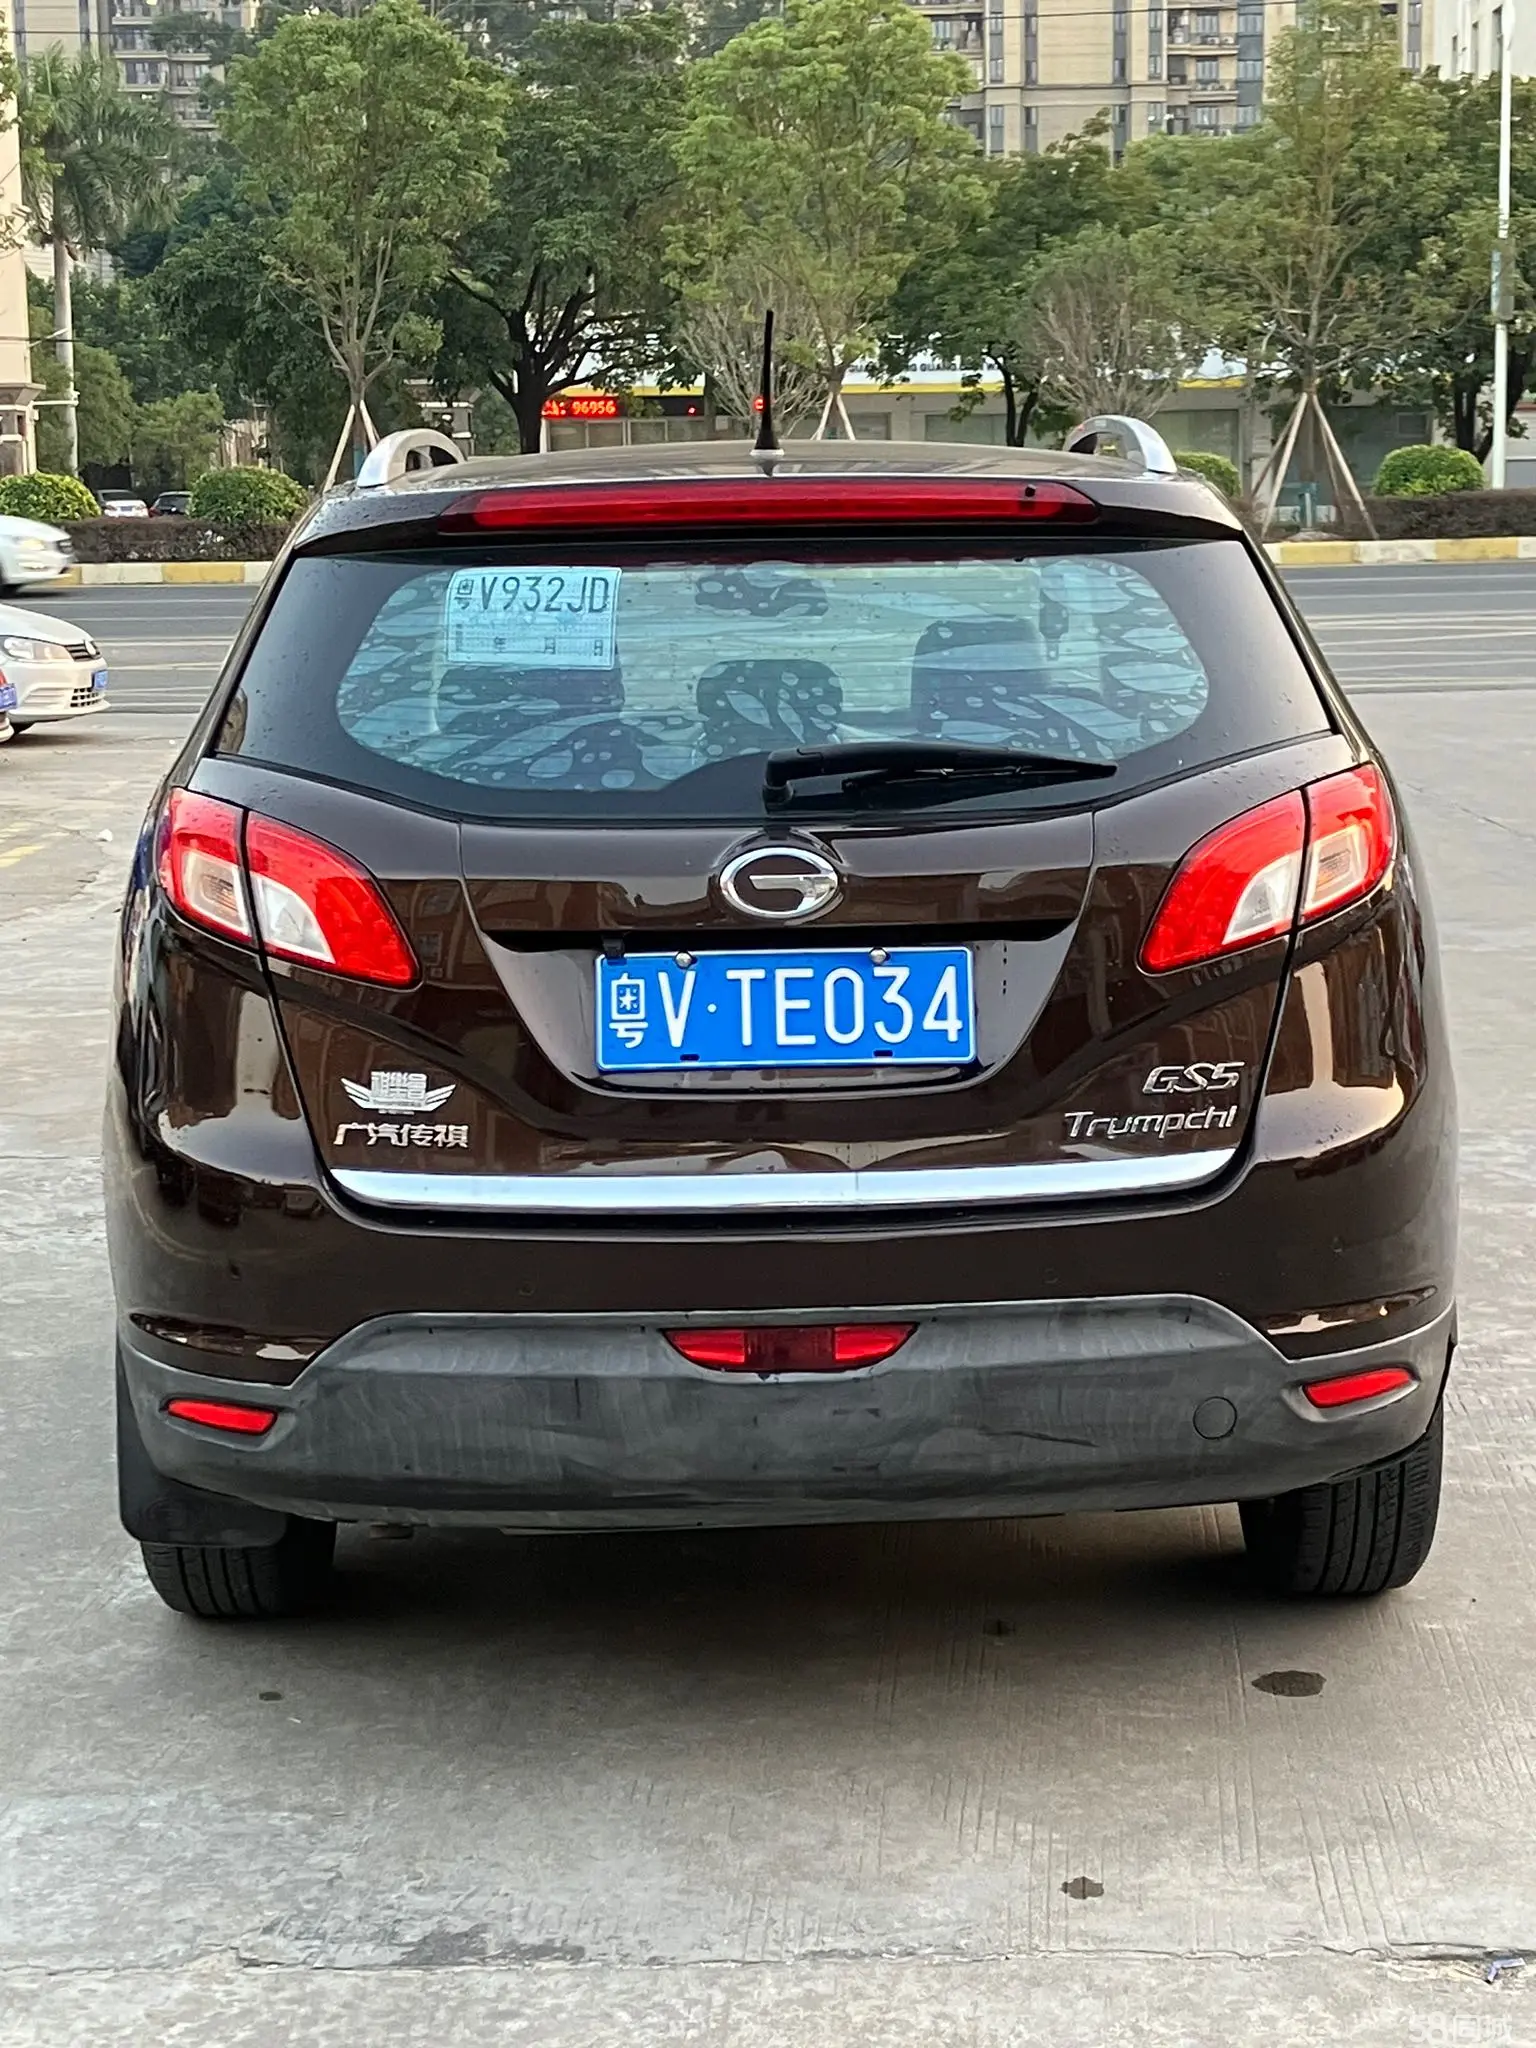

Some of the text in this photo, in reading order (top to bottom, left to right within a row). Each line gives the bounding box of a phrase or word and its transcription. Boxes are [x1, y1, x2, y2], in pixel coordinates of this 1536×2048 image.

[1142, 1061, 1245, 1094] GS5
[333, 1122, 470, 1148] 广汽传祺
